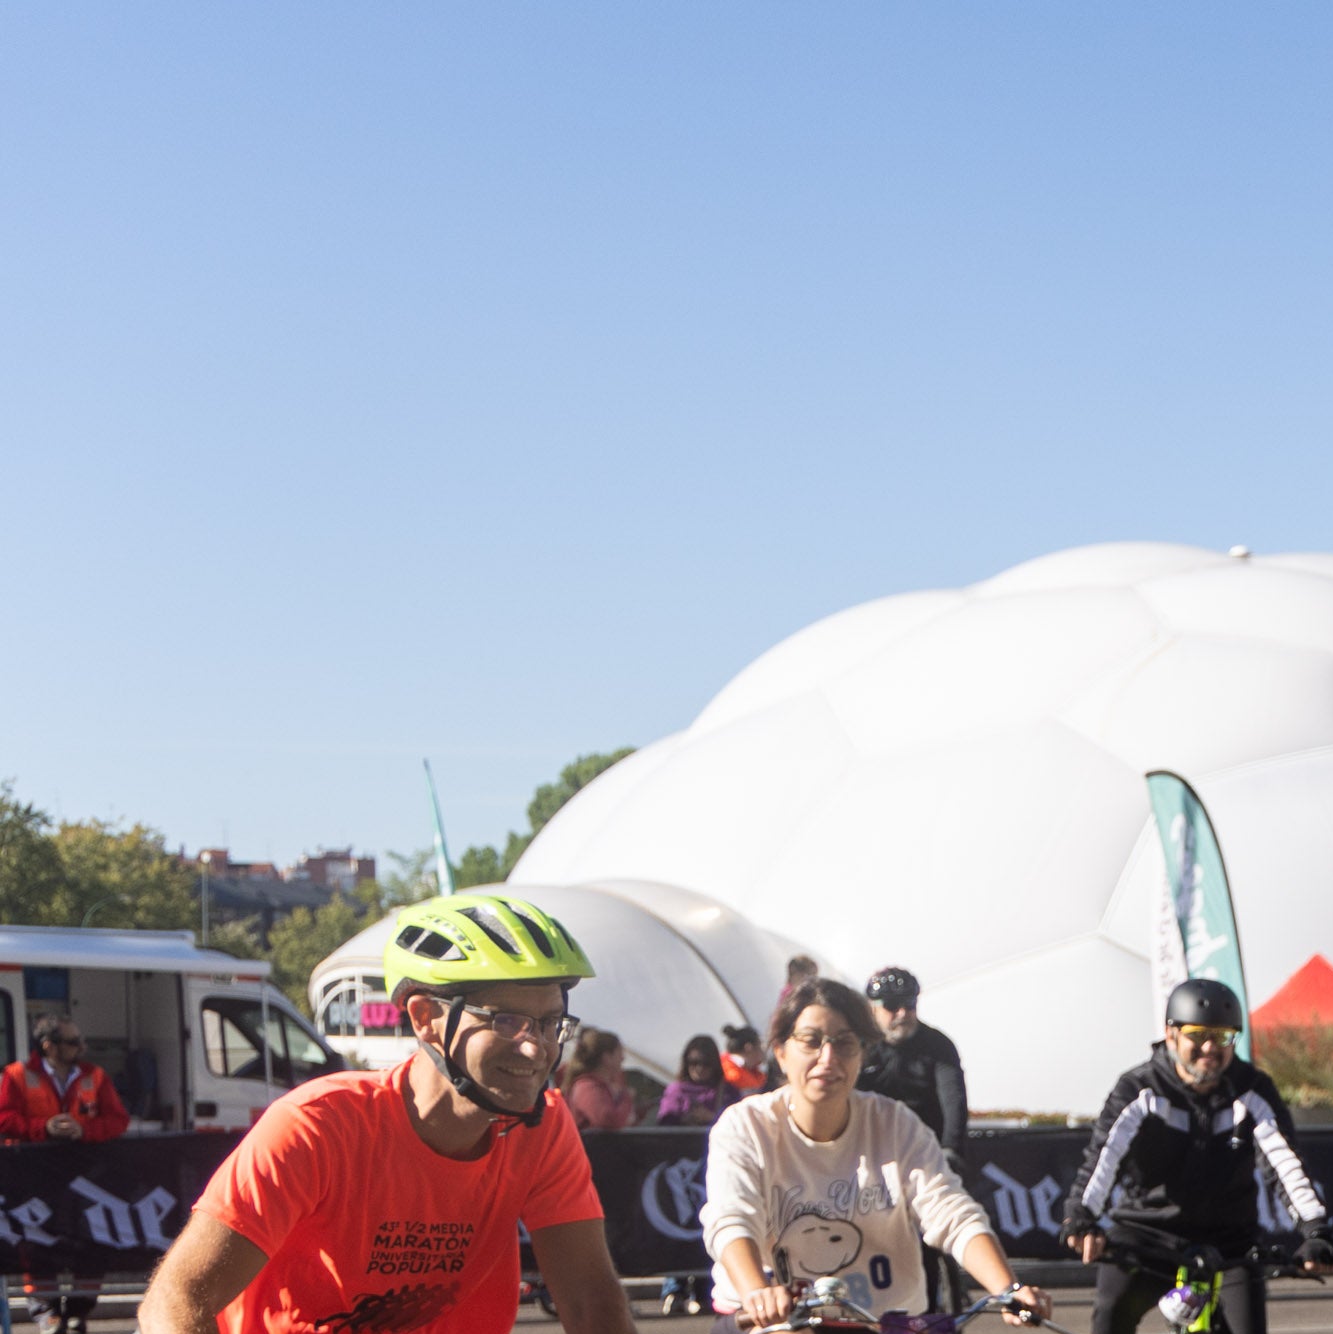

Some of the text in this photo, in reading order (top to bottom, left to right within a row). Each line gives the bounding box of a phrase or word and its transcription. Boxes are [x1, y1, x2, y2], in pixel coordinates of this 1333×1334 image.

[981, 1161, 1065, 1239] de
[68, 1175, 177, 1250] de
[429, 1222, 475, 1234] MEDIA
[373, 1233, 470, 1251] MARATÓN
[365, 1260, 465, 1275] POPULAR
